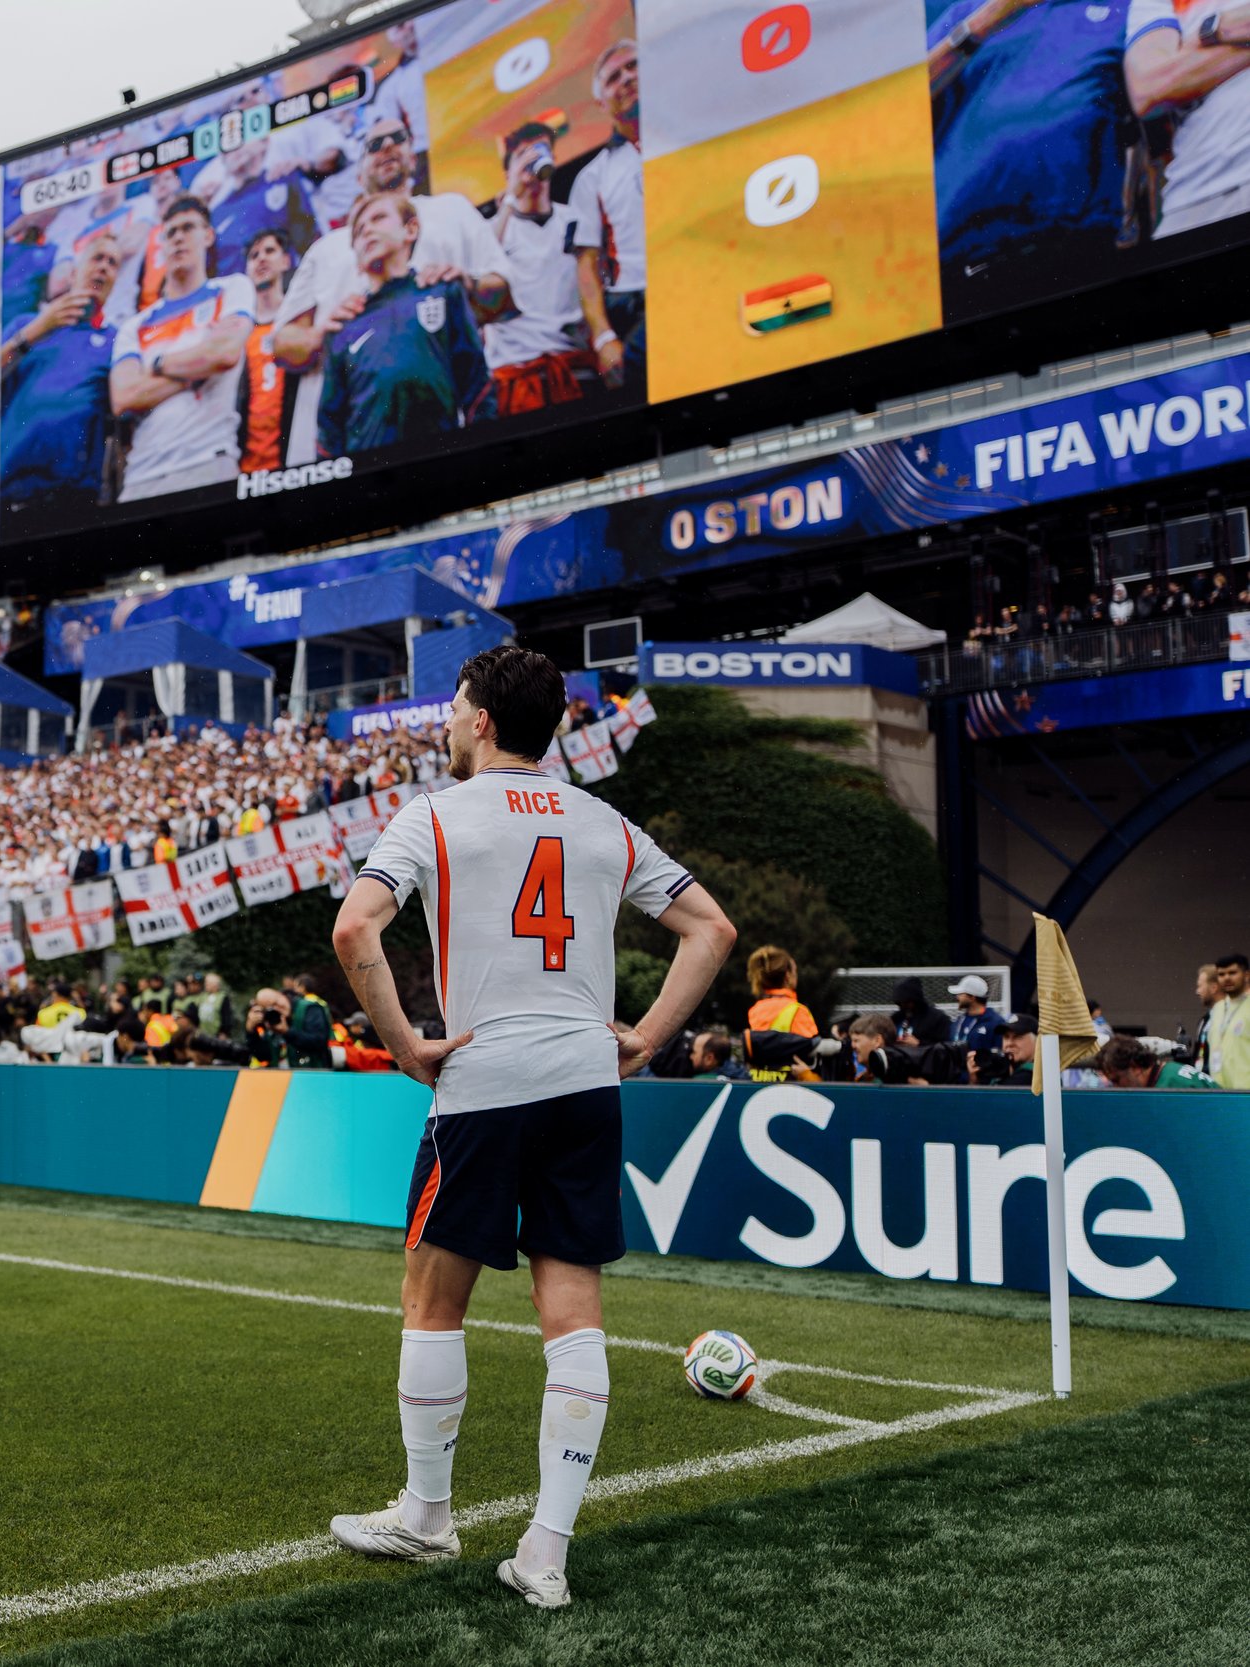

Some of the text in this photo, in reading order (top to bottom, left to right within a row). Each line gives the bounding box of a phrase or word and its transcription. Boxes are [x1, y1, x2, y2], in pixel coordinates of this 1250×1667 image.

[33, 170, 92, 204] 60:40
[200, 131, 215, 151] 0
[250, 114, 263, 133] 0
[974, 380, 1250, 489] FIFA WOR
[237, 456, 353, 500] Hisense
[704, 477, 842, 543] STON
[653, 652, 851, 678] BOSTON
[352, 711, 392, 736] FIFA
[505, 789, 565, 815] RICE
[511, 835, 575, 972] 4
[739, 1084, 1186, 1300] Sure
[562, 1448, 593, 1466] ENG
